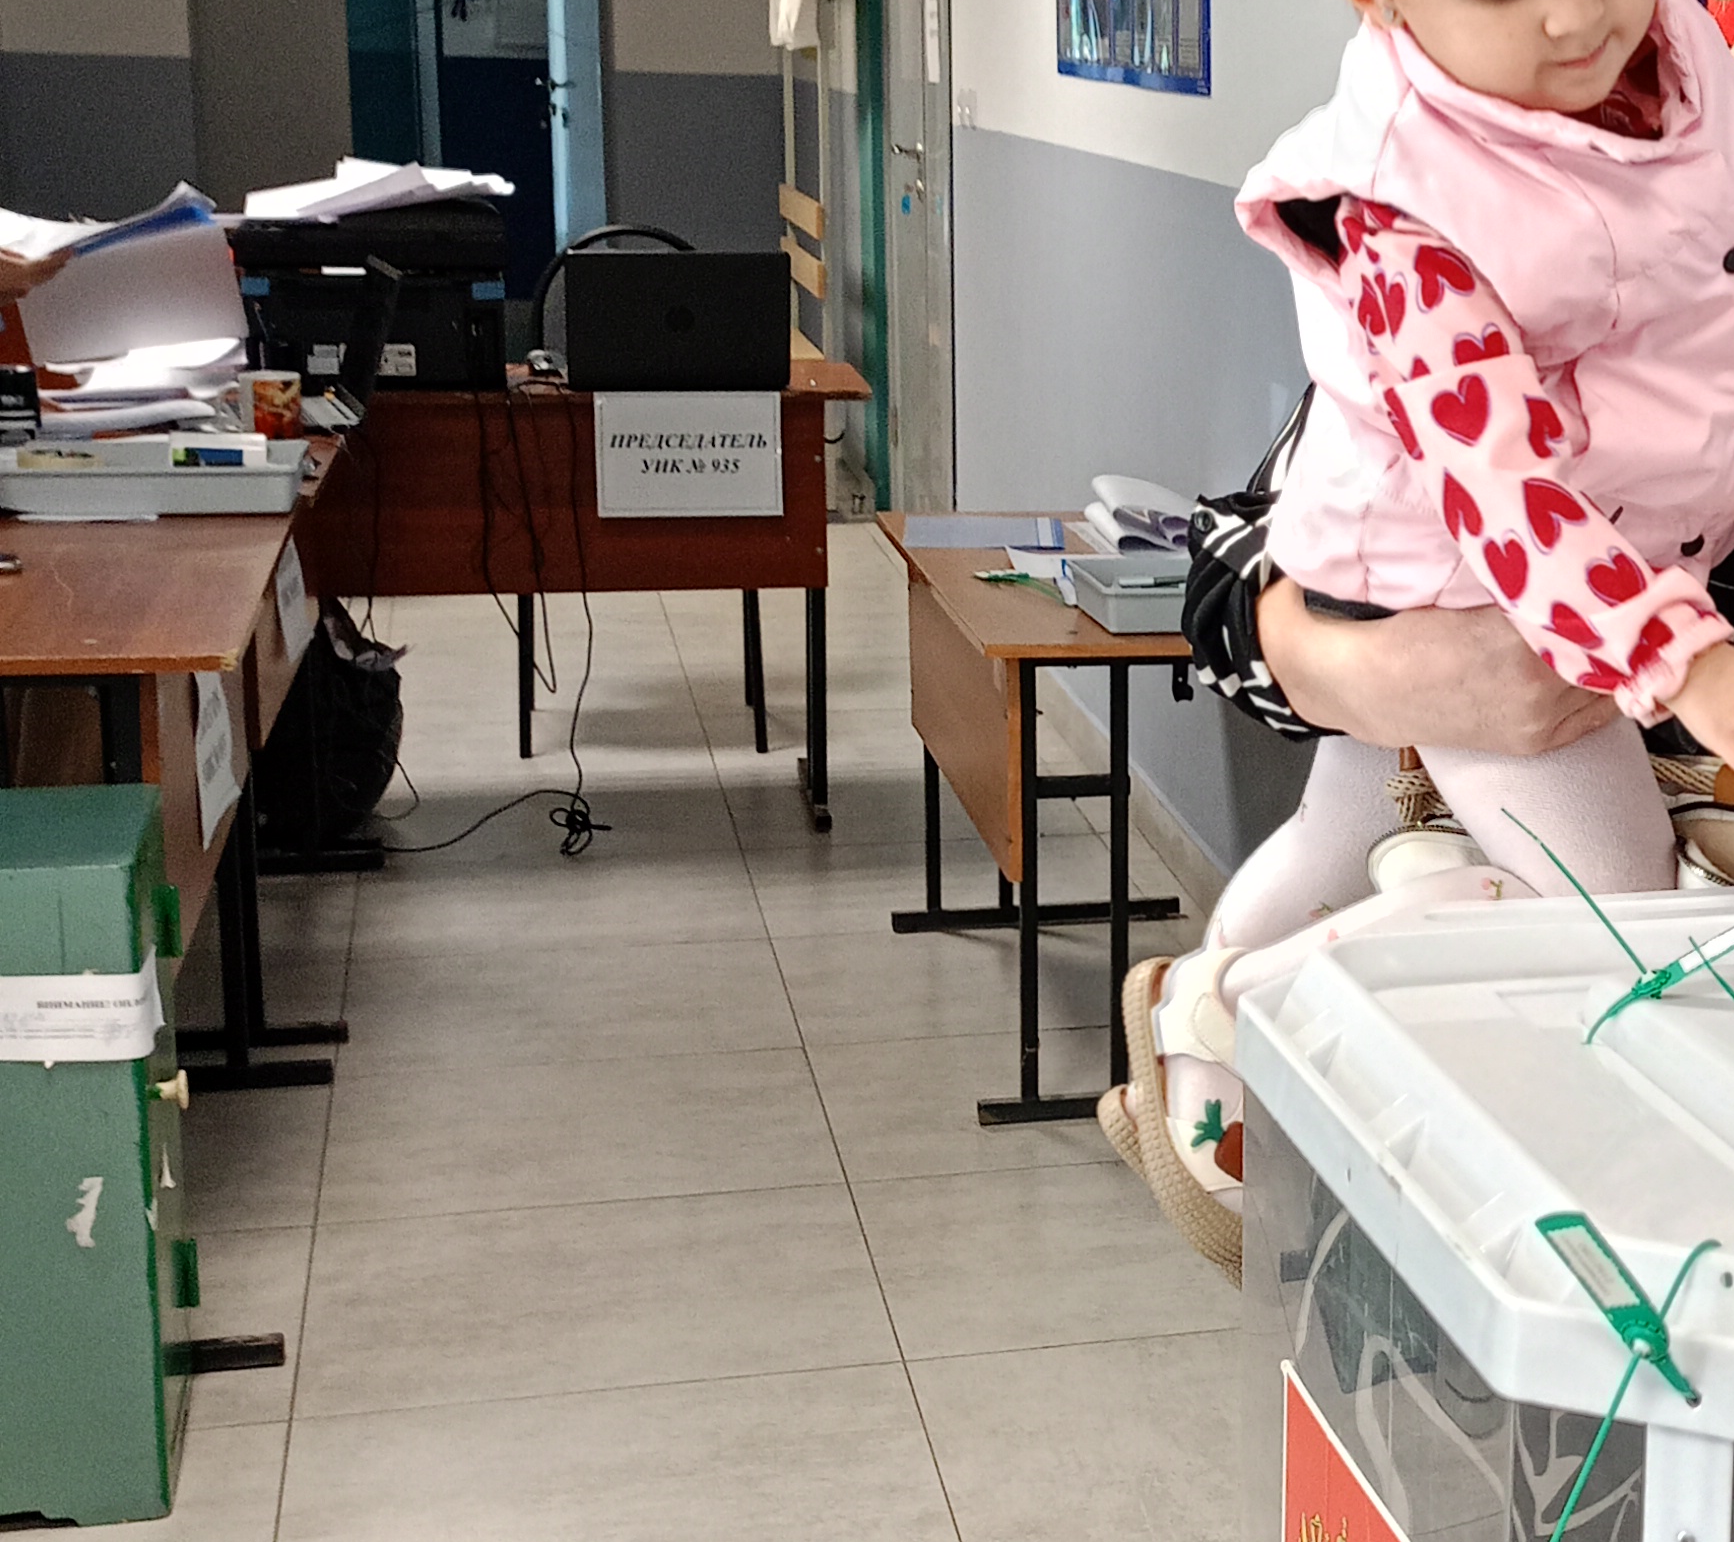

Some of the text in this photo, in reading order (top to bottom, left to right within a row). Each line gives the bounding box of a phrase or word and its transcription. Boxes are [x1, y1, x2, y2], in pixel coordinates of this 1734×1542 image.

[609, 433, 768, 450] ПРЕДСЕДАТЕЛЬ
[641, 459, 682, 474] УИК
[711, 459, 741, 473] 935
